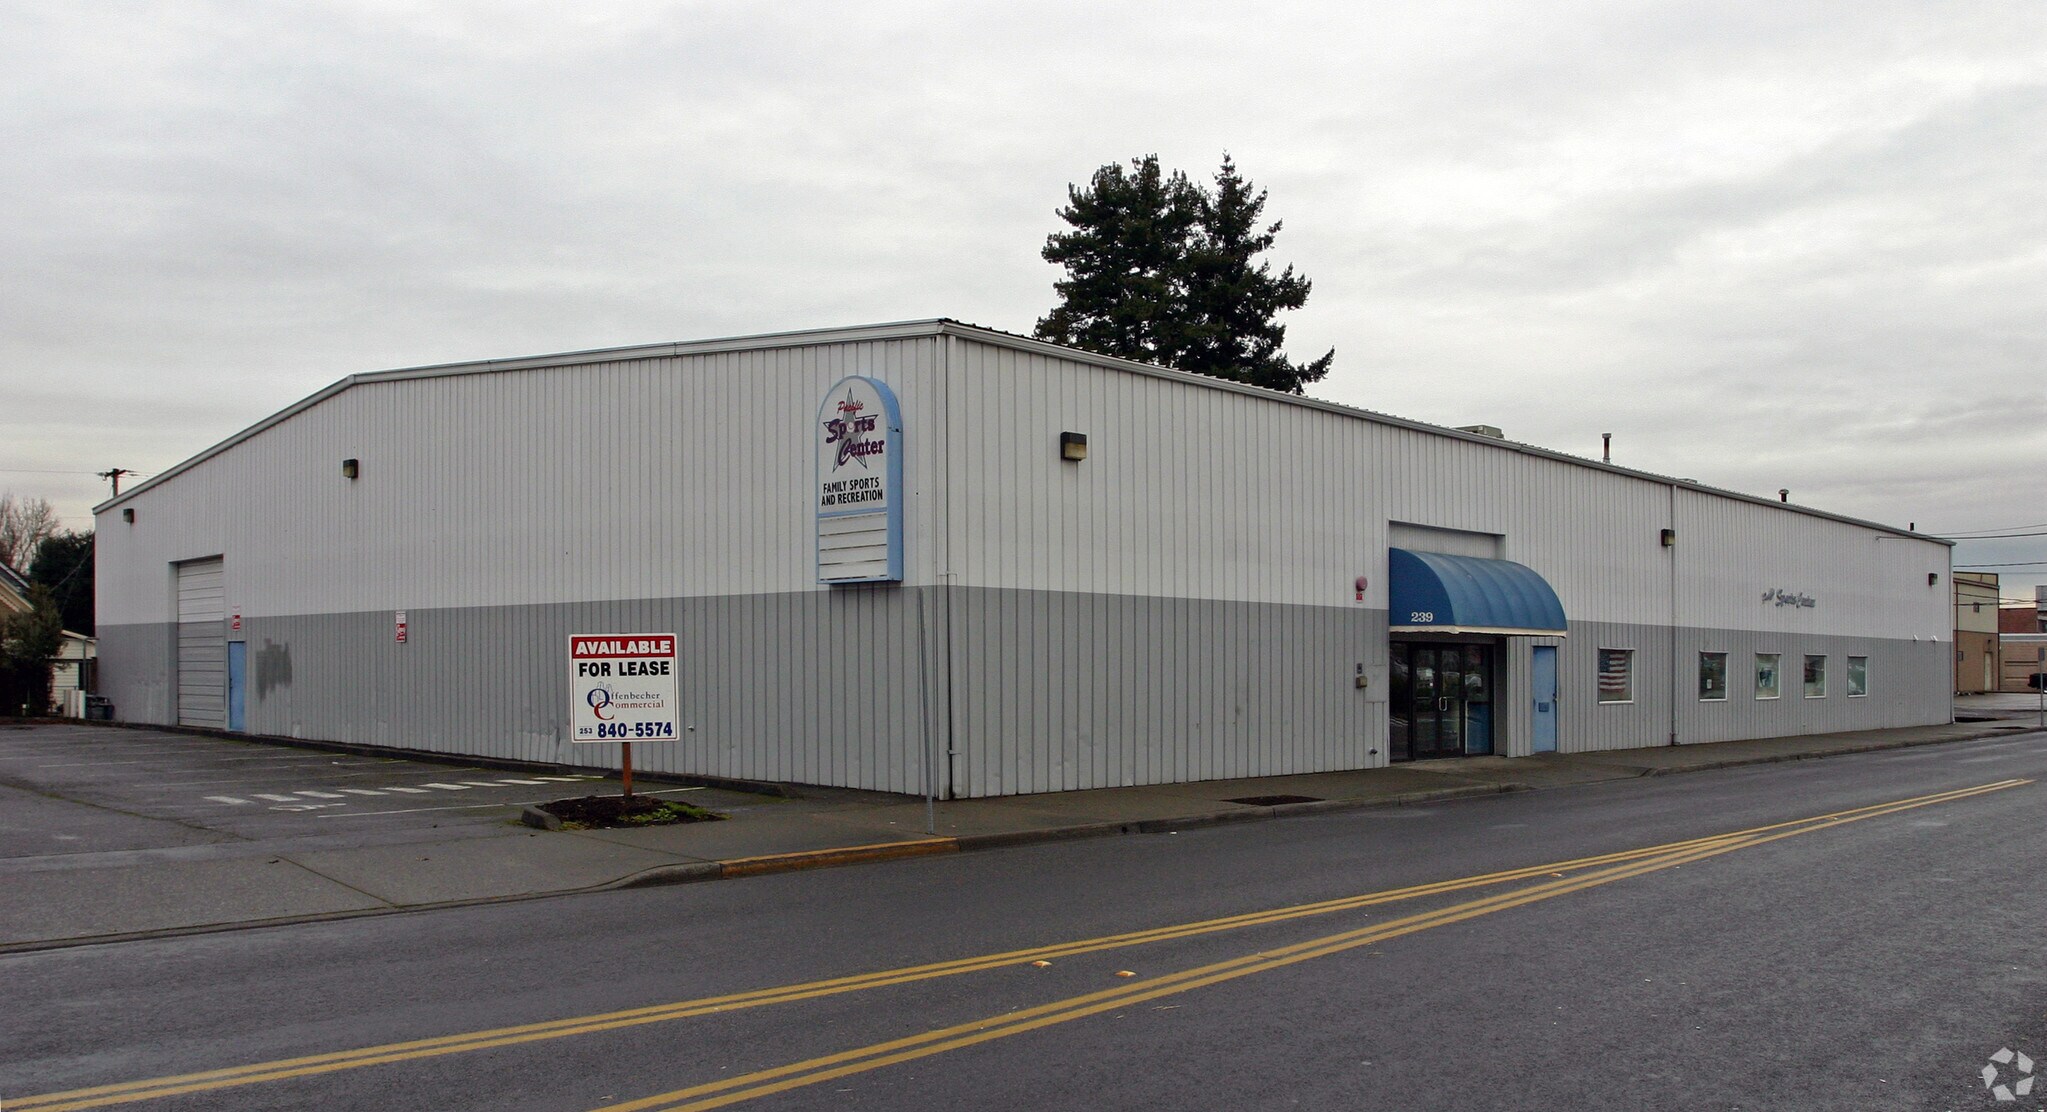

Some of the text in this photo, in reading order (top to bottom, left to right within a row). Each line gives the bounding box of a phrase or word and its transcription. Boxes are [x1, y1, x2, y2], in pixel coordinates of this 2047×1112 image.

[825, 418, 876, 444] Sports
[838, 438, 885, 466] Center
[823, 477, 880, 494] FAMILY SPORTS
[821, 489, 884, 507] AND RECREATION
[1410, 611, 1434, 623] 239
[575, 640, 671, 655] AVAILABLE
[578, 661, 670, 677] FOR LEASE
[586, 688, 660, 709] Offenbecher
[594, 700, 664, 720] Commercial
[579, 722, 673, 738] 253 840-5574
